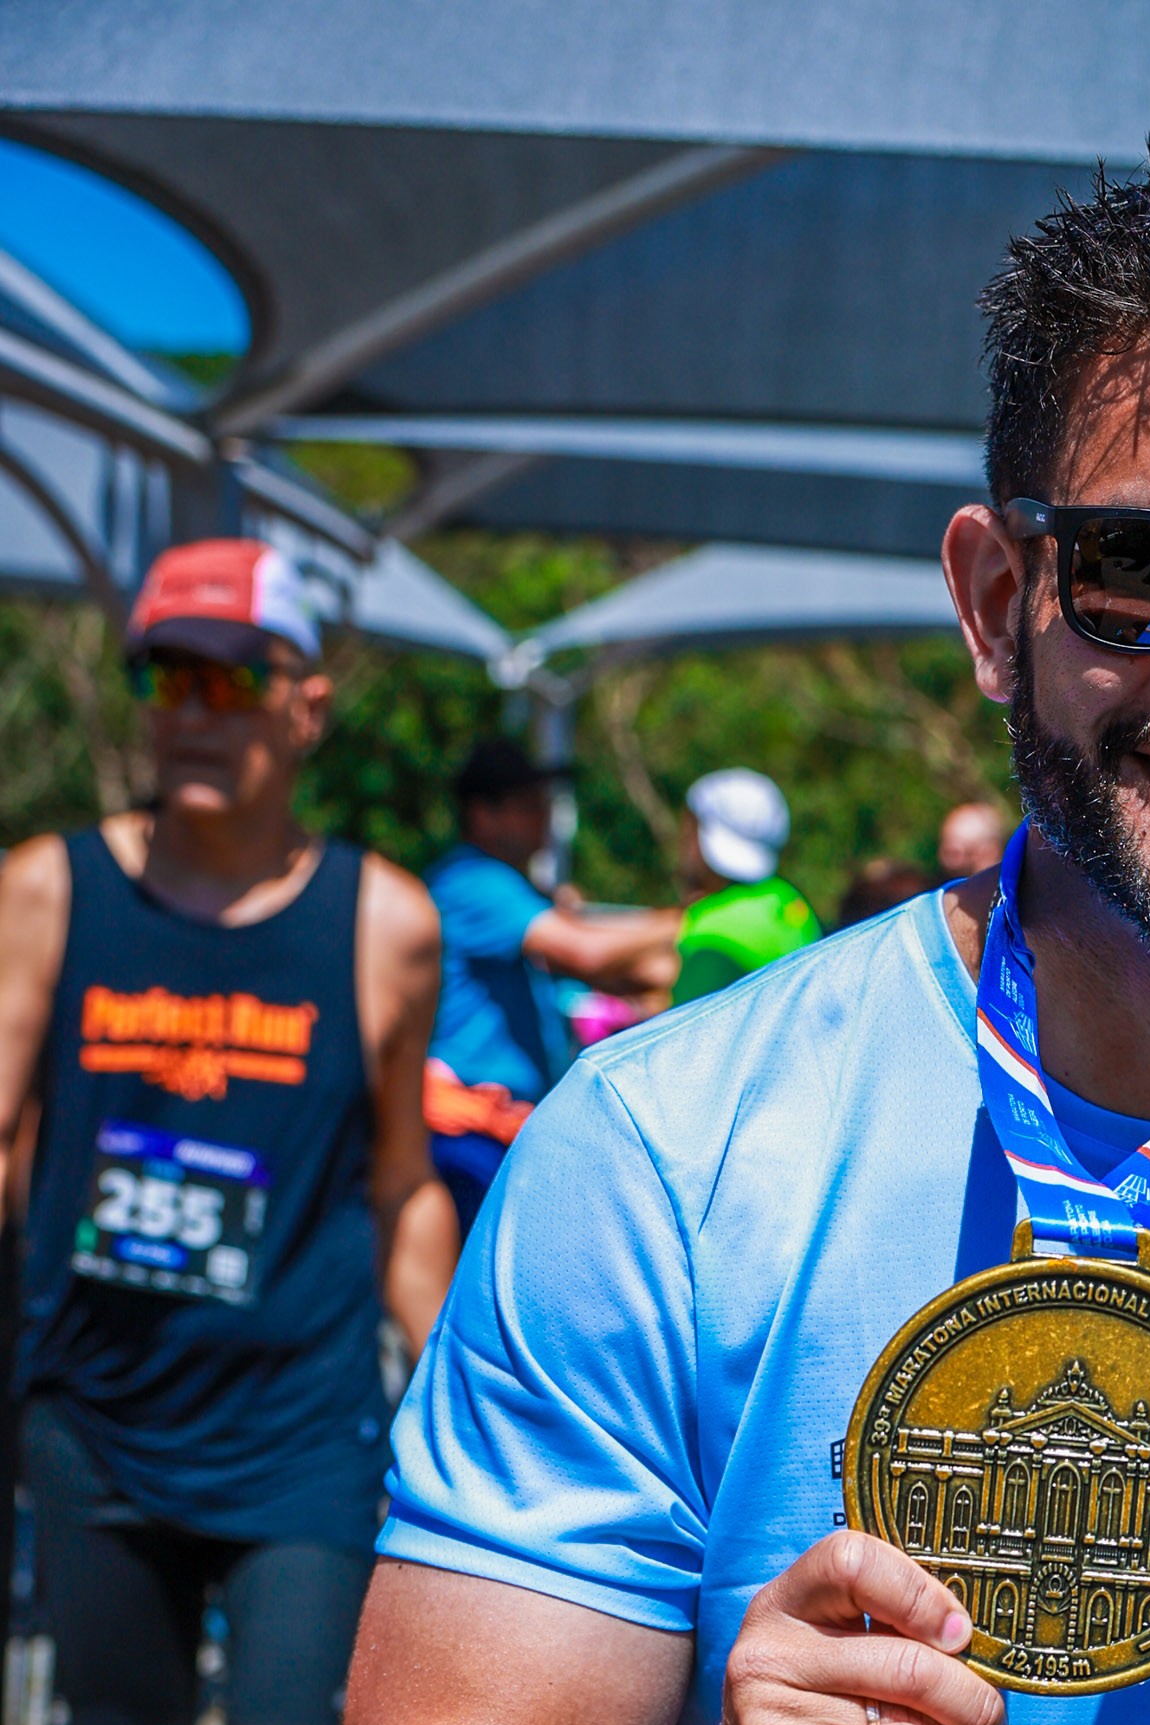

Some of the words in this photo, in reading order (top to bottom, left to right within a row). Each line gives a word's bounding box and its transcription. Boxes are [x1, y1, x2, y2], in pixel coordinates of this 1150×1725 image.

[93, 1167, 225, 1250] 255
[884, 1307, 977, 1405] MARATONA
[976, 1280, 1149, 1318] INTERNACIONAL
